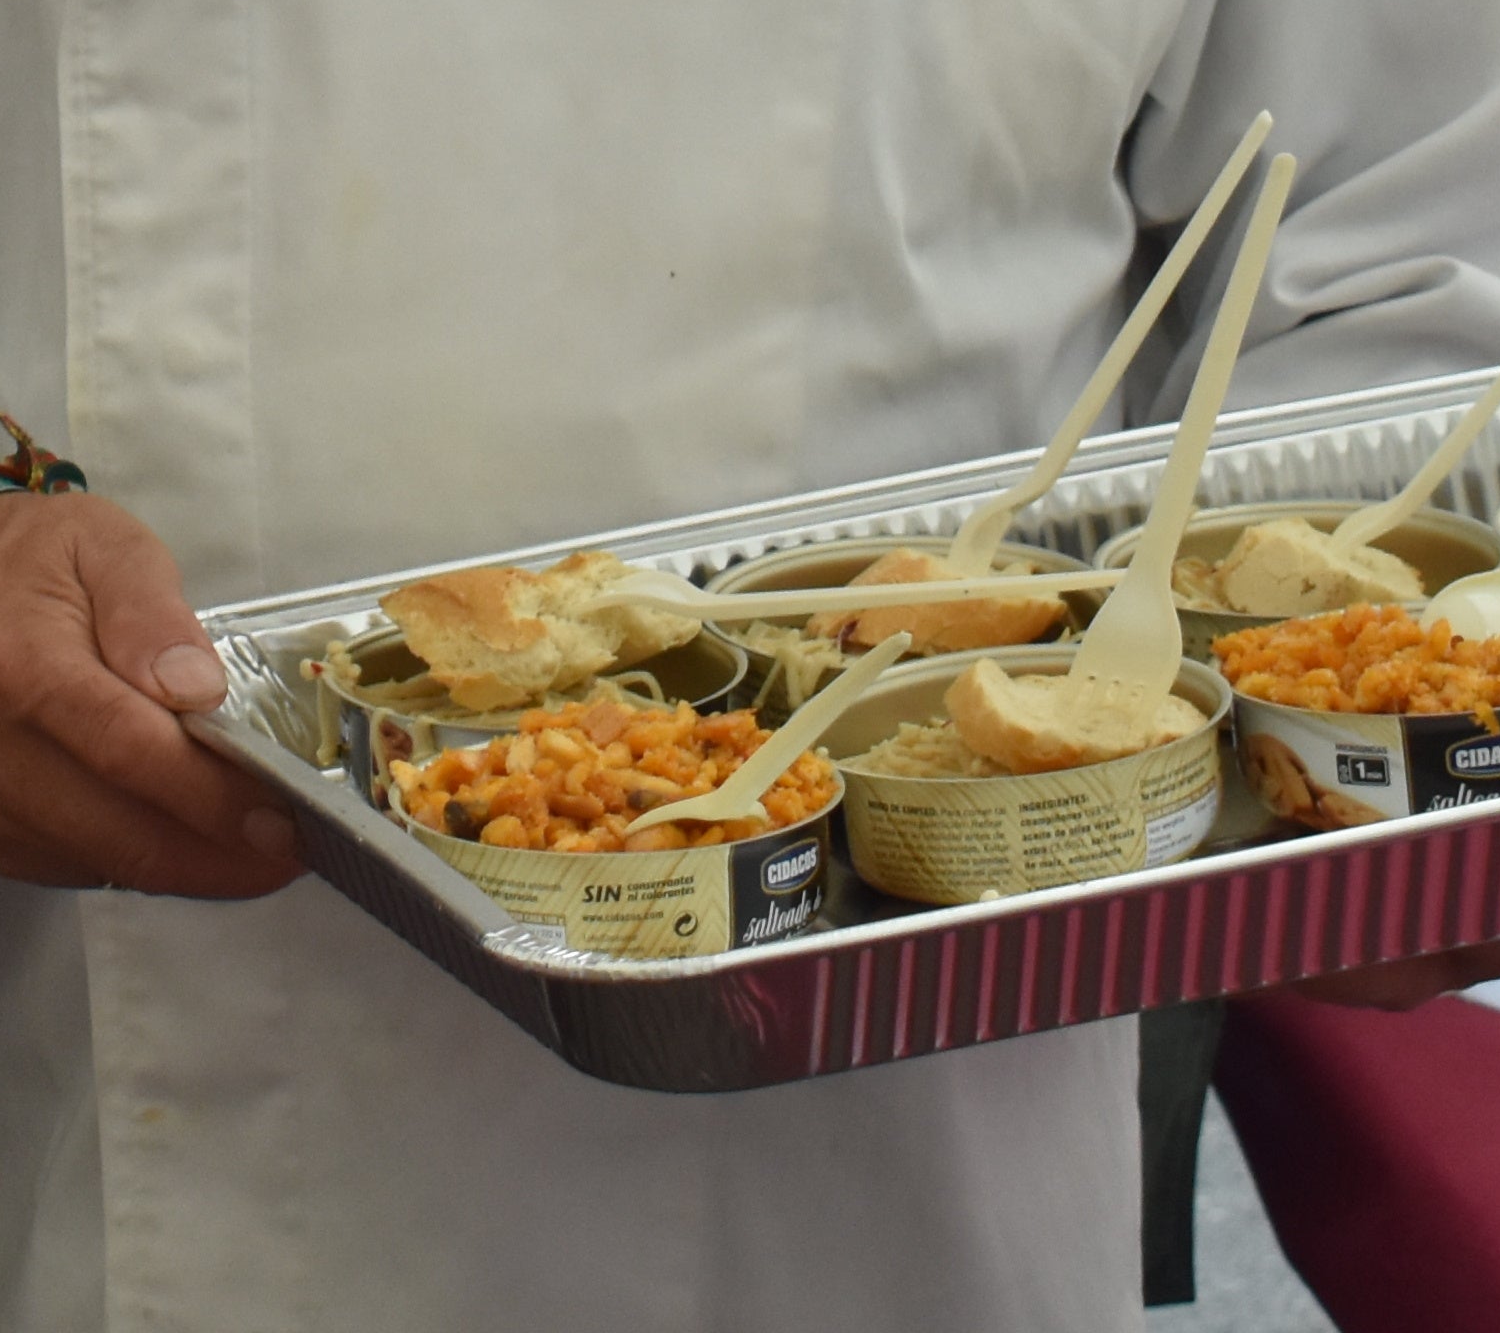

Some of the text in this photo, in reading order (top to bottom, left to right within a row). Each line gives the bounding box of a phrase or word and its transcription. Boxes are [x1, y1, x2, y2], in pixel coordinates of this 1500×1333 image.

[1355, 761, 1365, 779] 1
[767, 846, 817, 884] CIDACOS
[582, 875, 695, 903] SIN conservantes
[627, 886, 695, 902] ni colorantes
